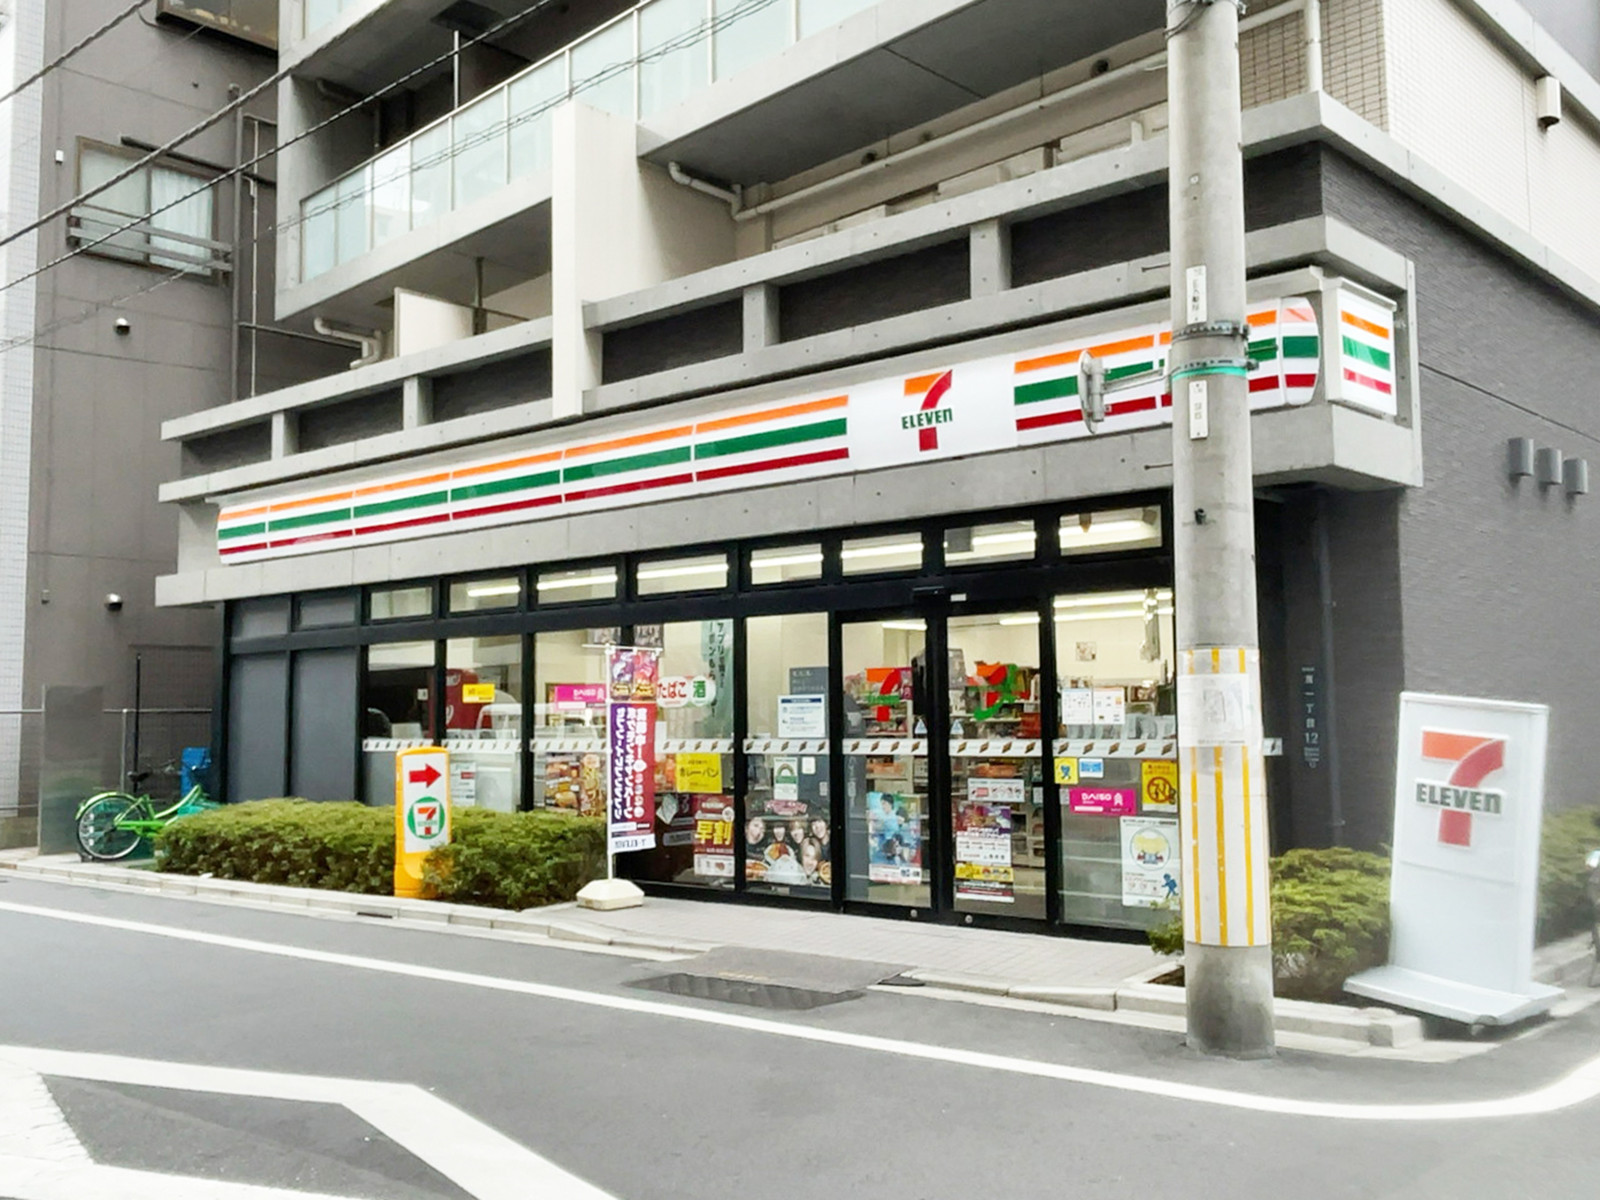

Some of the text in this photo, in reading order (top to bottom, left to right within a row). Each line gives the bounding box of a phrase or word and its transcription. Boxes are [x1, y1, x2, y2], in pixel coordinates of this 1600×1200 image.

[693, 681, 706, 699] 酒
[1305, 732, 1319, 745] 12
[695, 820, 734, 846] 早割
